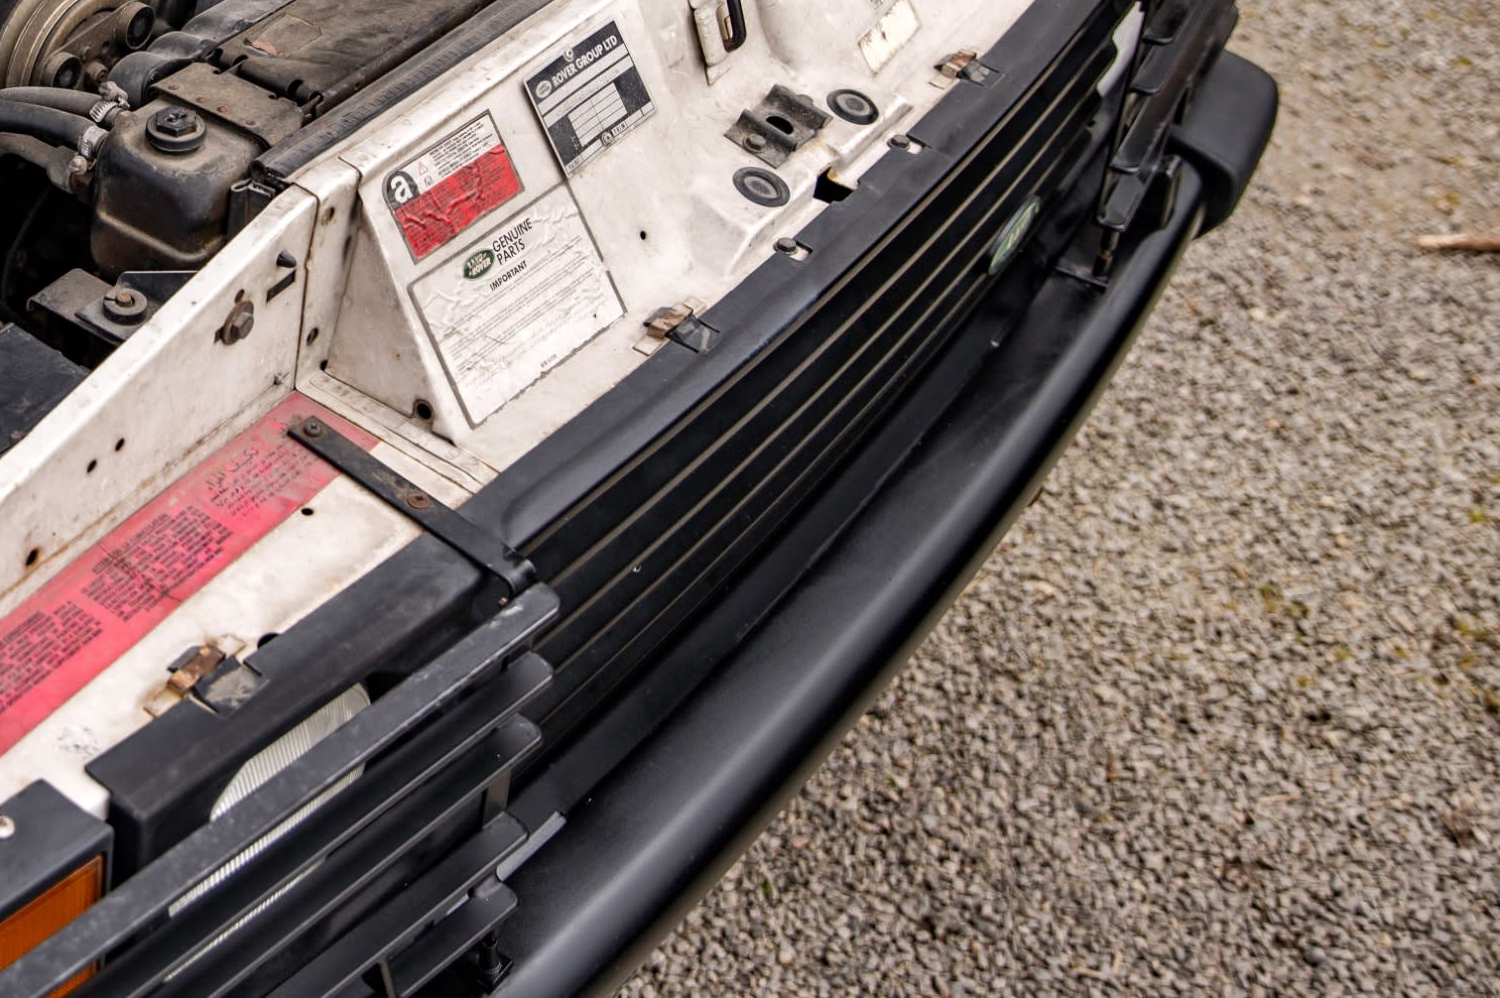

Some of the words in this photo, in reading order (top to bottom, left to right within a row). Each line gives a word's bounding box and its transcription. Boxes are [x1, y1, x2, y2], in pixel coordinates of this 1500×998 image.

[552, 64, 578, 88] ROVER
[576, 43, 604, 70] GROUP
[602, 34, 618, 51] LTD
[390, 174, 413, 203] a
[492, 217, 533, 252] GENUINE
[496, 240, 526, 265] PARTS
[489, 260, 528, 291] IMPORTANT
